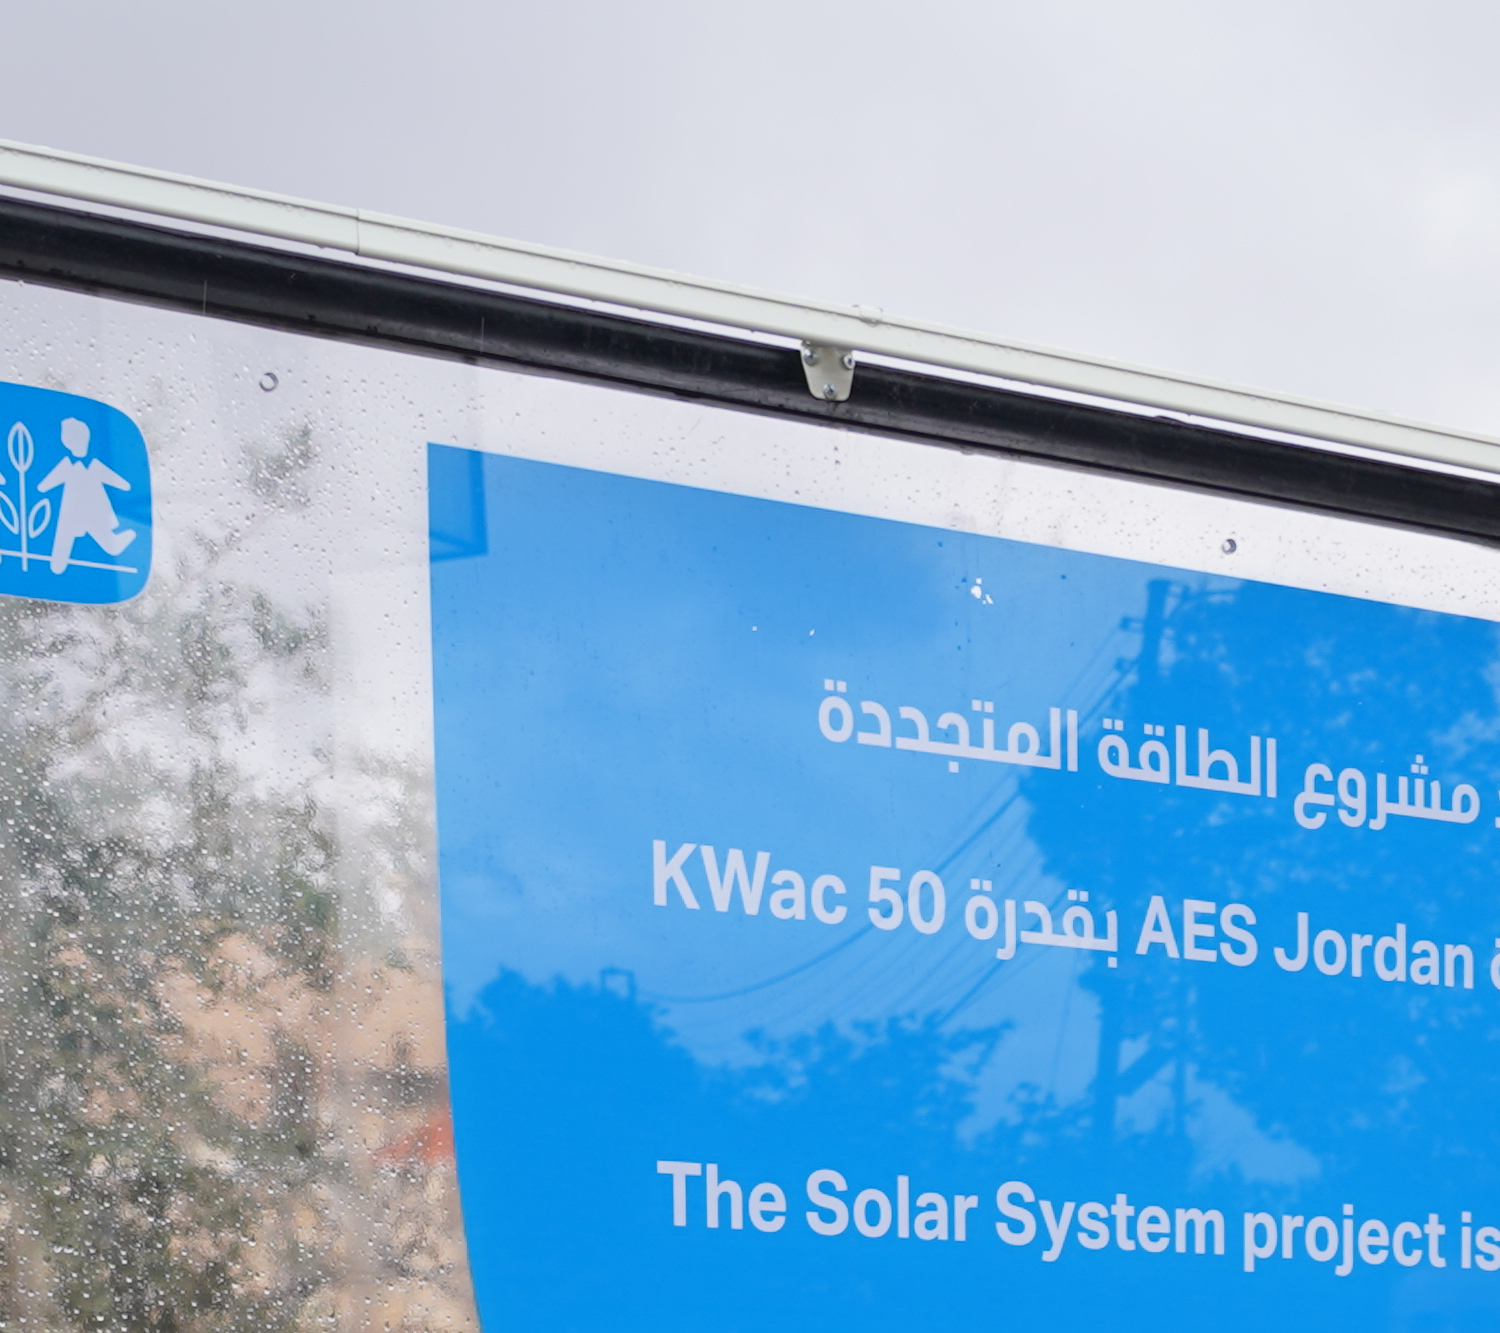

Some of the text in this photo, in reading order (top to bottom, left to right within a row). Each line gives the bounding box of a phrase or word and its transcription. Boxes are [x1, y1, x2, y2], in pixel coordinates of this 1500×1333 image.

[818, 678, 1079, 774] المتجددة
[1097, 717, 1278, 799] الطاقة
[1293, 753, 1481, 831] مشروع
[652, 839, 848, 925] KWac
[867, 865, 947, 935] 50
[964, 878, 1119, 969] بقدرة
[1134, 894, 1259, 968] AES
[1272, 911, 1475, 990] Jordan
[656, 1159, 788, 1233] The
[805, 1167, 980, 1242] Solar
[994, 1180, 1226, 1263] System
[1242, 1202, 1448, 1278] project
